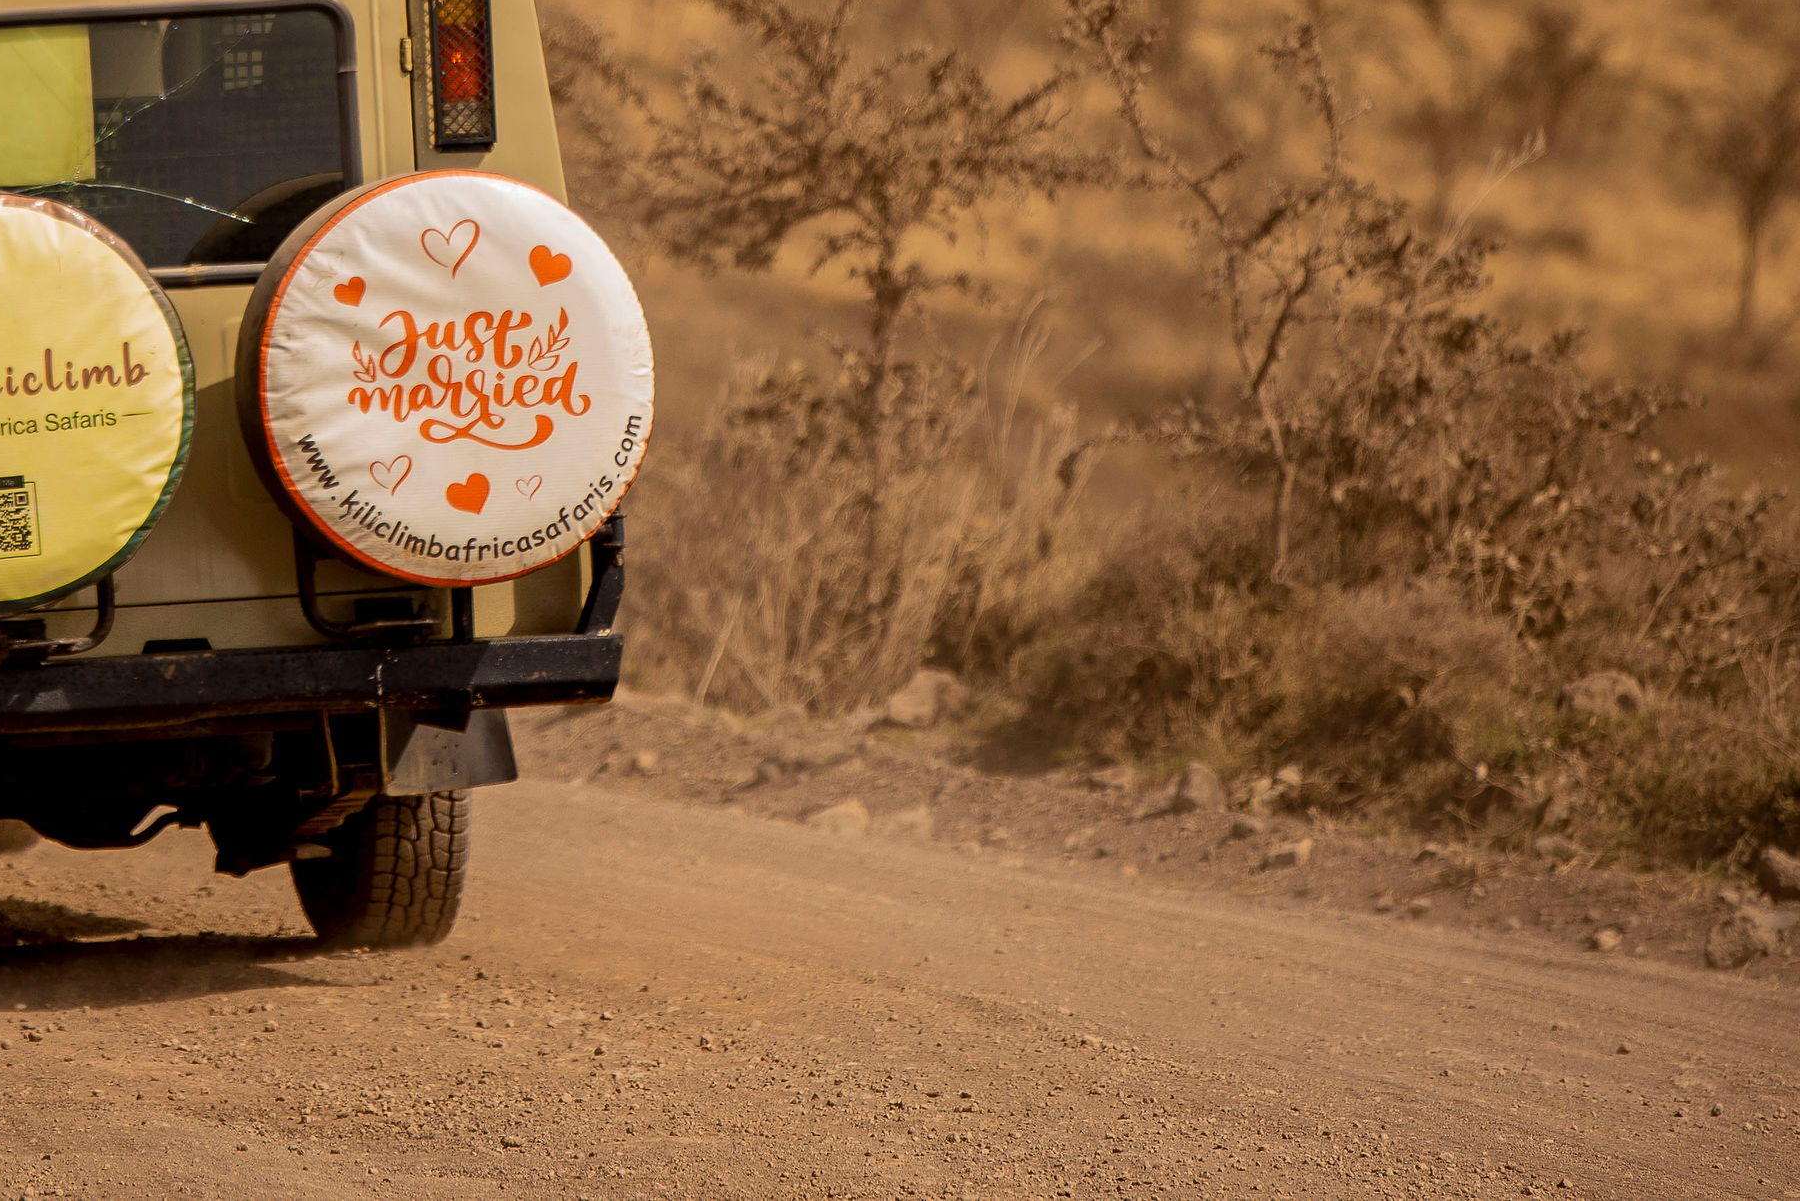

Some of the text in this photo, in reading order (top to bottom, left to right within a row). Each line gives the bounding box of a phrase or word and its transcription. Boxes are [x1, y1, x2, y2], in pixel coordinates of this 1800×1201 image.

[378, 309, 533, 379] Just
[45, 409, 117, 432] Safaris
[347, 354, 592, 450] married
[297, 413, 643, 563] www.kiliclimbafricasafaris.com
